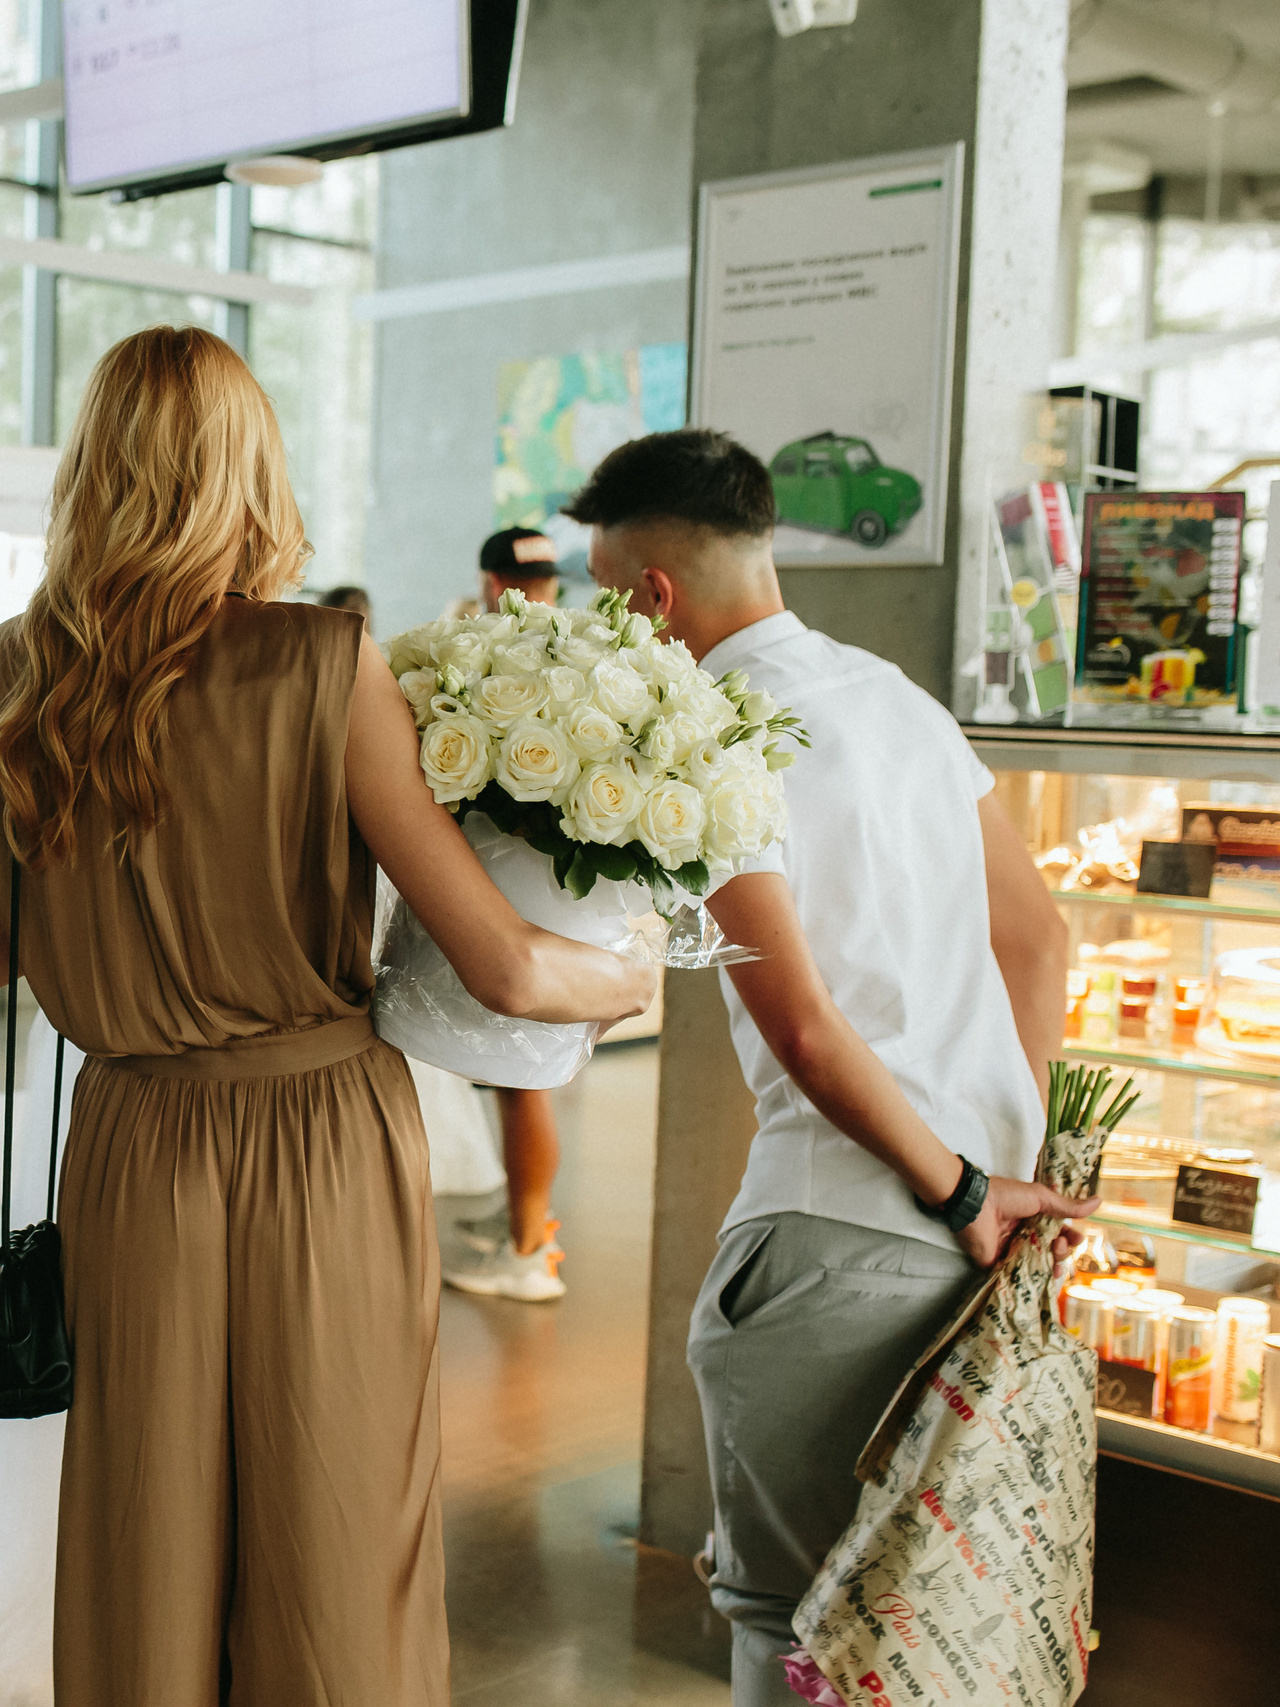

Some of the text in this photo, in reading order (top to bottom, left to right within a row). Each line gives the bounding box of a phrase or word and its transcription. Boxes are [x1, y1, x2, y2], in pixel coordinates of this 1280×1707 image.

[924, 1367, 978, 1423] ondon
[954, 1358, 1002, 1401] York
[1046, 1367, 1090, 1449] London
[997, 1401, 1058, 1495] London
[992, 1459, 1026, 1503] London
[1054, 1467, 1081, 1524] New York
[916, 1485, 959, 1535] New
[1019, 1503, 1063, 1564] Paris
[981, 1537, 1027, 1599] New York
[986, 1495, 1052, 1590] New York
[1067, 1550, 1085, 1584] Paris
[865, 1583, 930, 1655] Paris
[918, 1570, 960, 1618] Paris
[949, 1569, 987, 1619] New York
[1039, 1576, 1077, 1635] Paris
[1078, 1585, 1091, 1624] New
[914, 1606, 982, 1698] London
[950, 1626, 986, 1672] London
[1025, 1594, 1079, 1698] London
[1025, 1631, 1052, 1675] London
[833, 1669, 857, 1696] New
[886, 1650, 926, 1700] New
